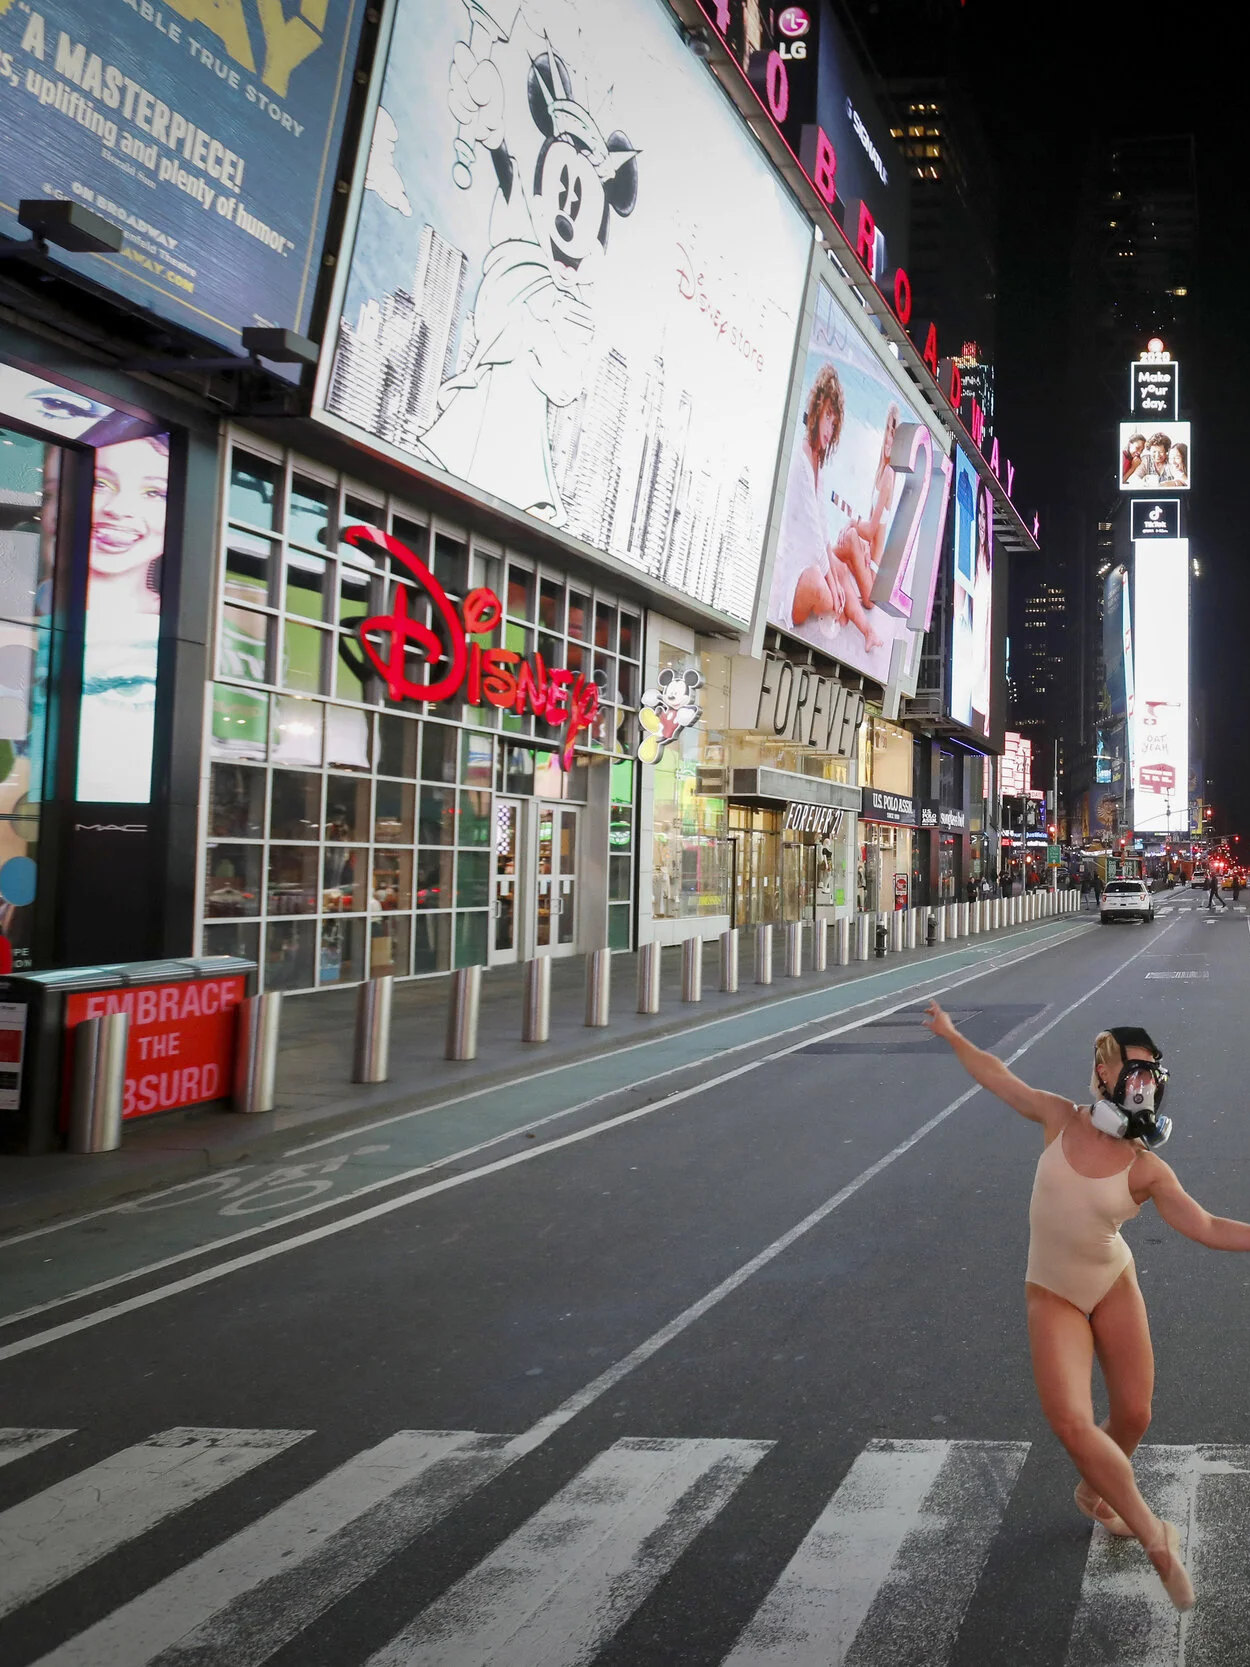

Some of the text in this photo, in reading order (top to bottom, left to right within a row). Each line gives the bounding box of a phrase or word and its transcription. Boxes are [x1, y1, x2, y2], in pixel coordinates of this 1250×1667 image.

[779, 41, 807, 60] LG
[187, 36, 241, 90] TRUE
[245, 84, 305, 138] STORY
[55, 30, 246, 194] MASTERPIECE!
[26, 69, 117, 148] uplifting
[120, 125, 158, 170] and
[159, 155, 213, 211] plenty
[216, 193, 237, 223] of
[97, 193, 179, 250] BROADWAY
[730, 326, 765, 373] store
[1138, 371, 1171, 383] Make
[1140, 384, 1169, 399] your
[1142, 397, 1167, 411] day.
[754, 650, 867, 759] FOREVER
[786, 802, 845, 835] FOREVER 21
[873, 793, 883, 809] U.S.
[884, 795, 898, 812] POLO
[86, 980, 237, 1026] EMBRACE
[138, 1032, 181, 1061] THE
[122, 1063, 219, 1116] BSURD
